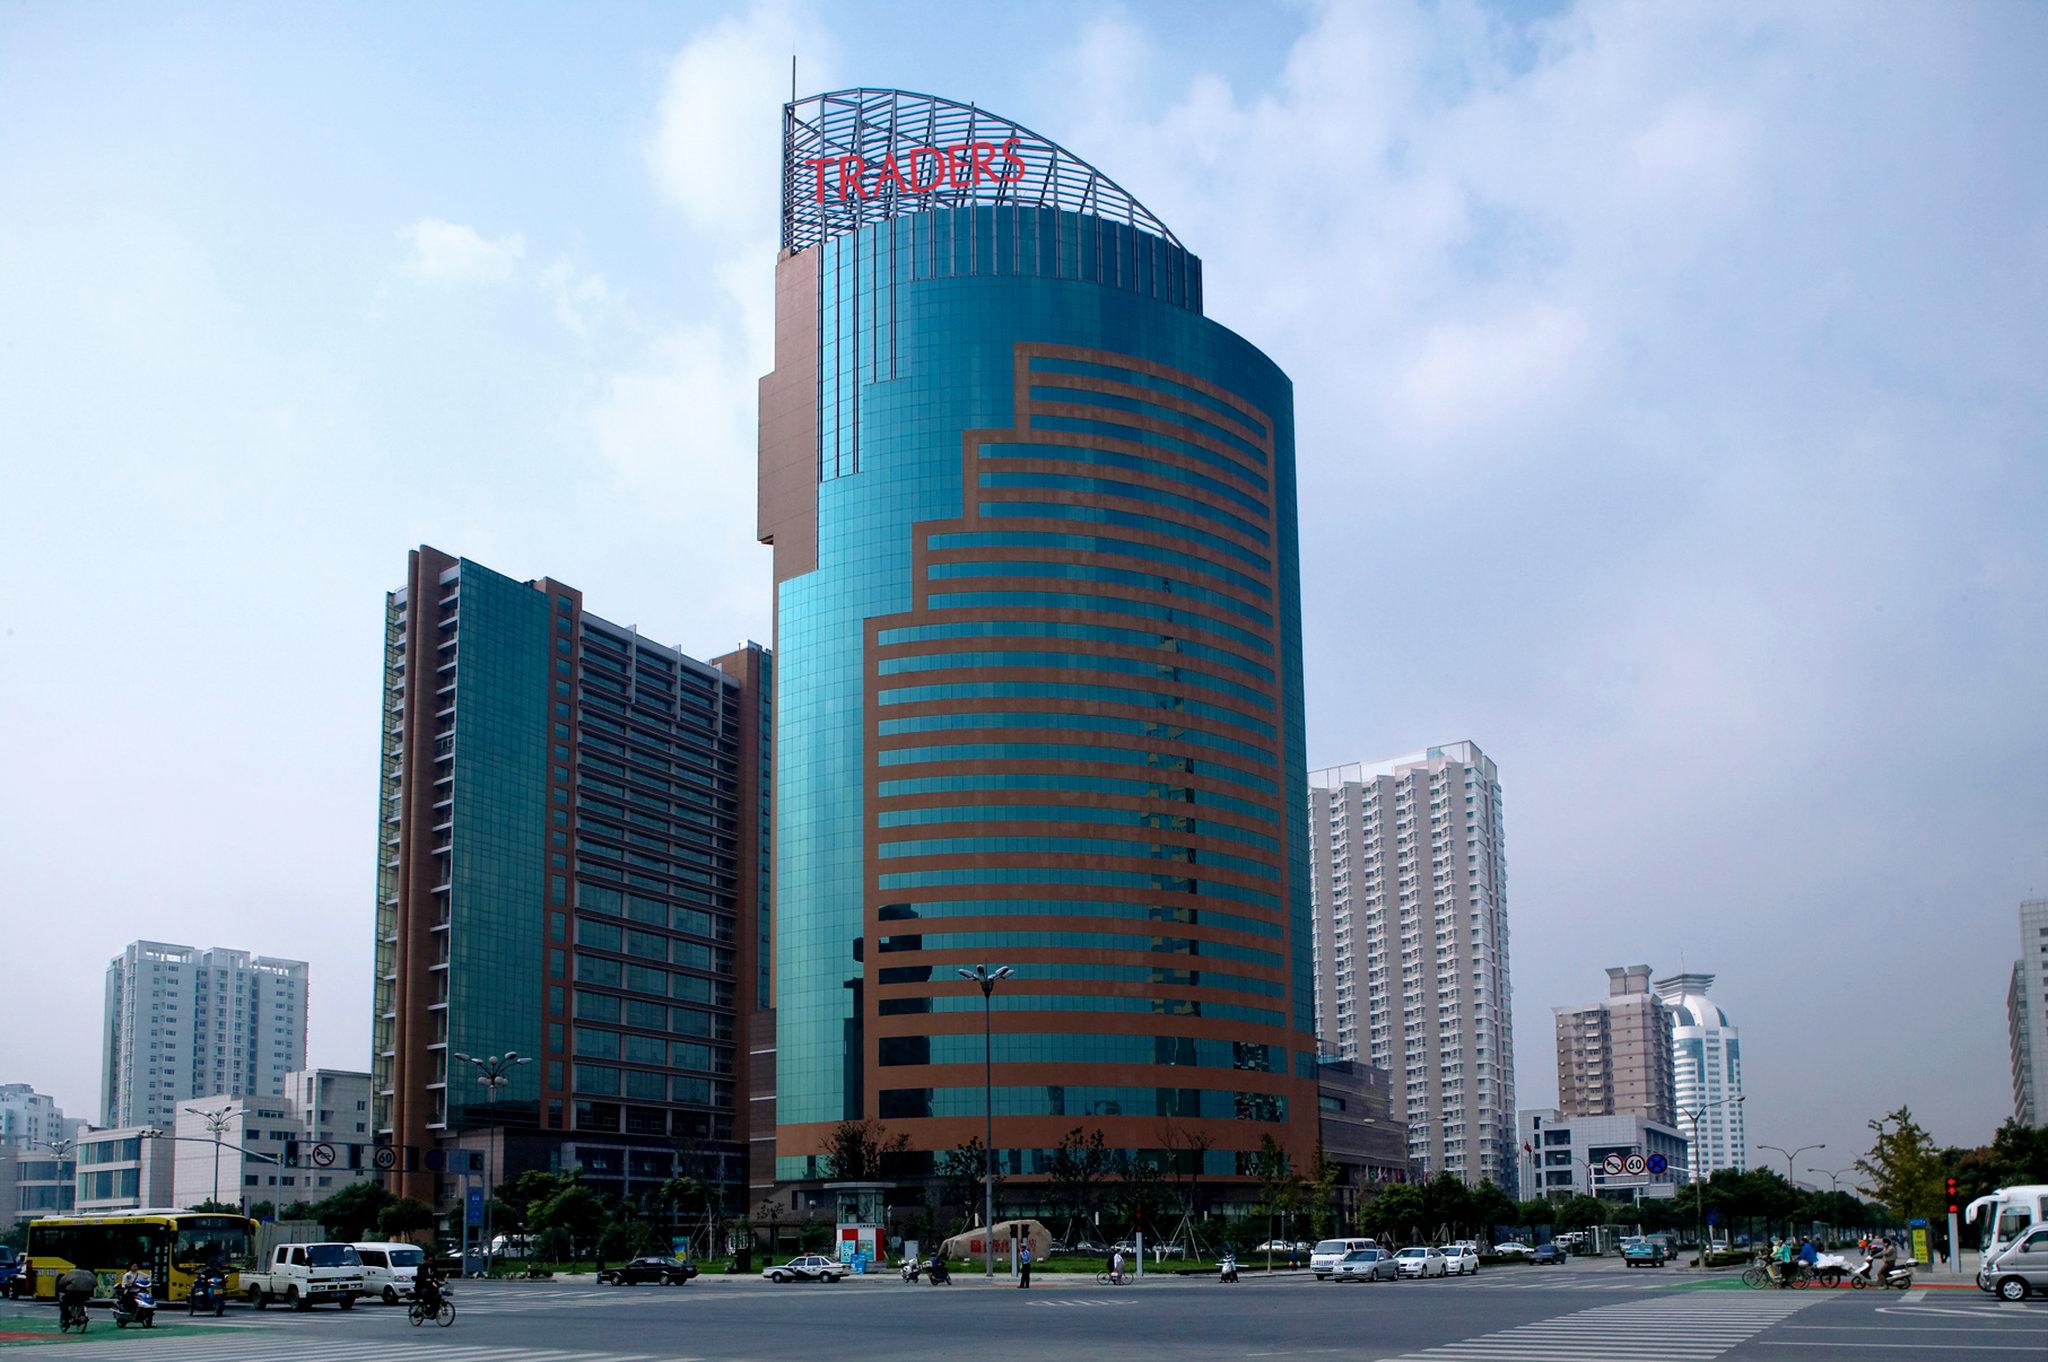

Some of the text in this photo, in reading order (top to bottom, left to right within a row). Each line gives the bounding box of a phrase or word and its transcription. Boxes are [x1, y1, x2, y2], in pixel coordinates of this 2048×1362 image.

[806, 137, 1025, 204] TRADERS
[379, 1153, 391, 1163] 60
[1628, 1160, 1641, 1169] 60
